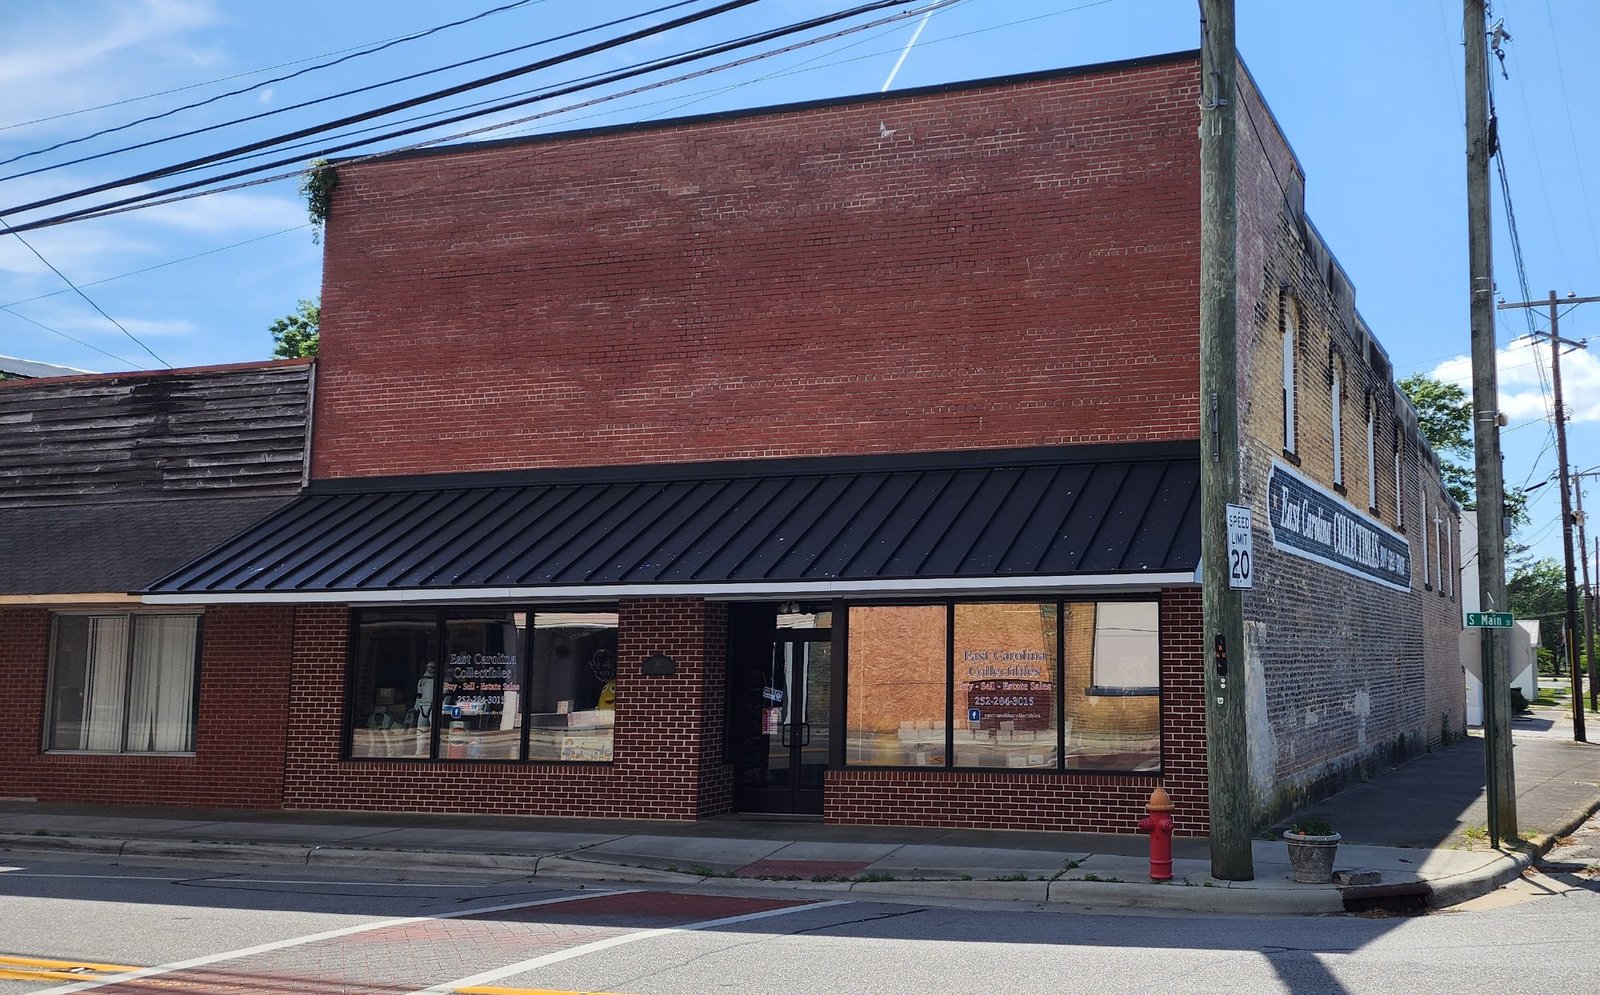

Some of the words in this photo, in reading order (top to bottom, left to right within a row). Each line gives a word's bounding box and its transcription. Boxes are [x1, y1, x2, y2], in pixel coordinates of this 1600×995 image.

[1229, 515, 1249, 529] SPEED
[1280, 486, 1300, 533] East
[1302, 499, 1332, 546] Carolina
[1334, 512, 1380, 569] COLLECTIBLES
[1231, 531, 1247, 546] LIMIT
[1231, 549, 1250, 579] 20
[1469, 614, 1475, 625] S
[1481, 614, 1502, 625] Main
[449, 653, 472, 665] East
[473, 652, 517, 665] Carolina
[964, 650, 988, 661] East
[993, 649, 1047, 661] Carolina
[453, 666, 513, 679] Collectibles
[968, 664, 1041, 677] Collectibles
[443, 682, 458, 692] Buy
[462, 682, 476, 691] Sell
[480, 682, 501, 691] Estate
[502, 682, 520, 691] Sales
[980, 682, 996, 691] Sell
[1002, 682, 1029, 691] Estate
[1029, 682, 1052, 691] Sales
[974, 696, 1035, 706] 252-284-3015
